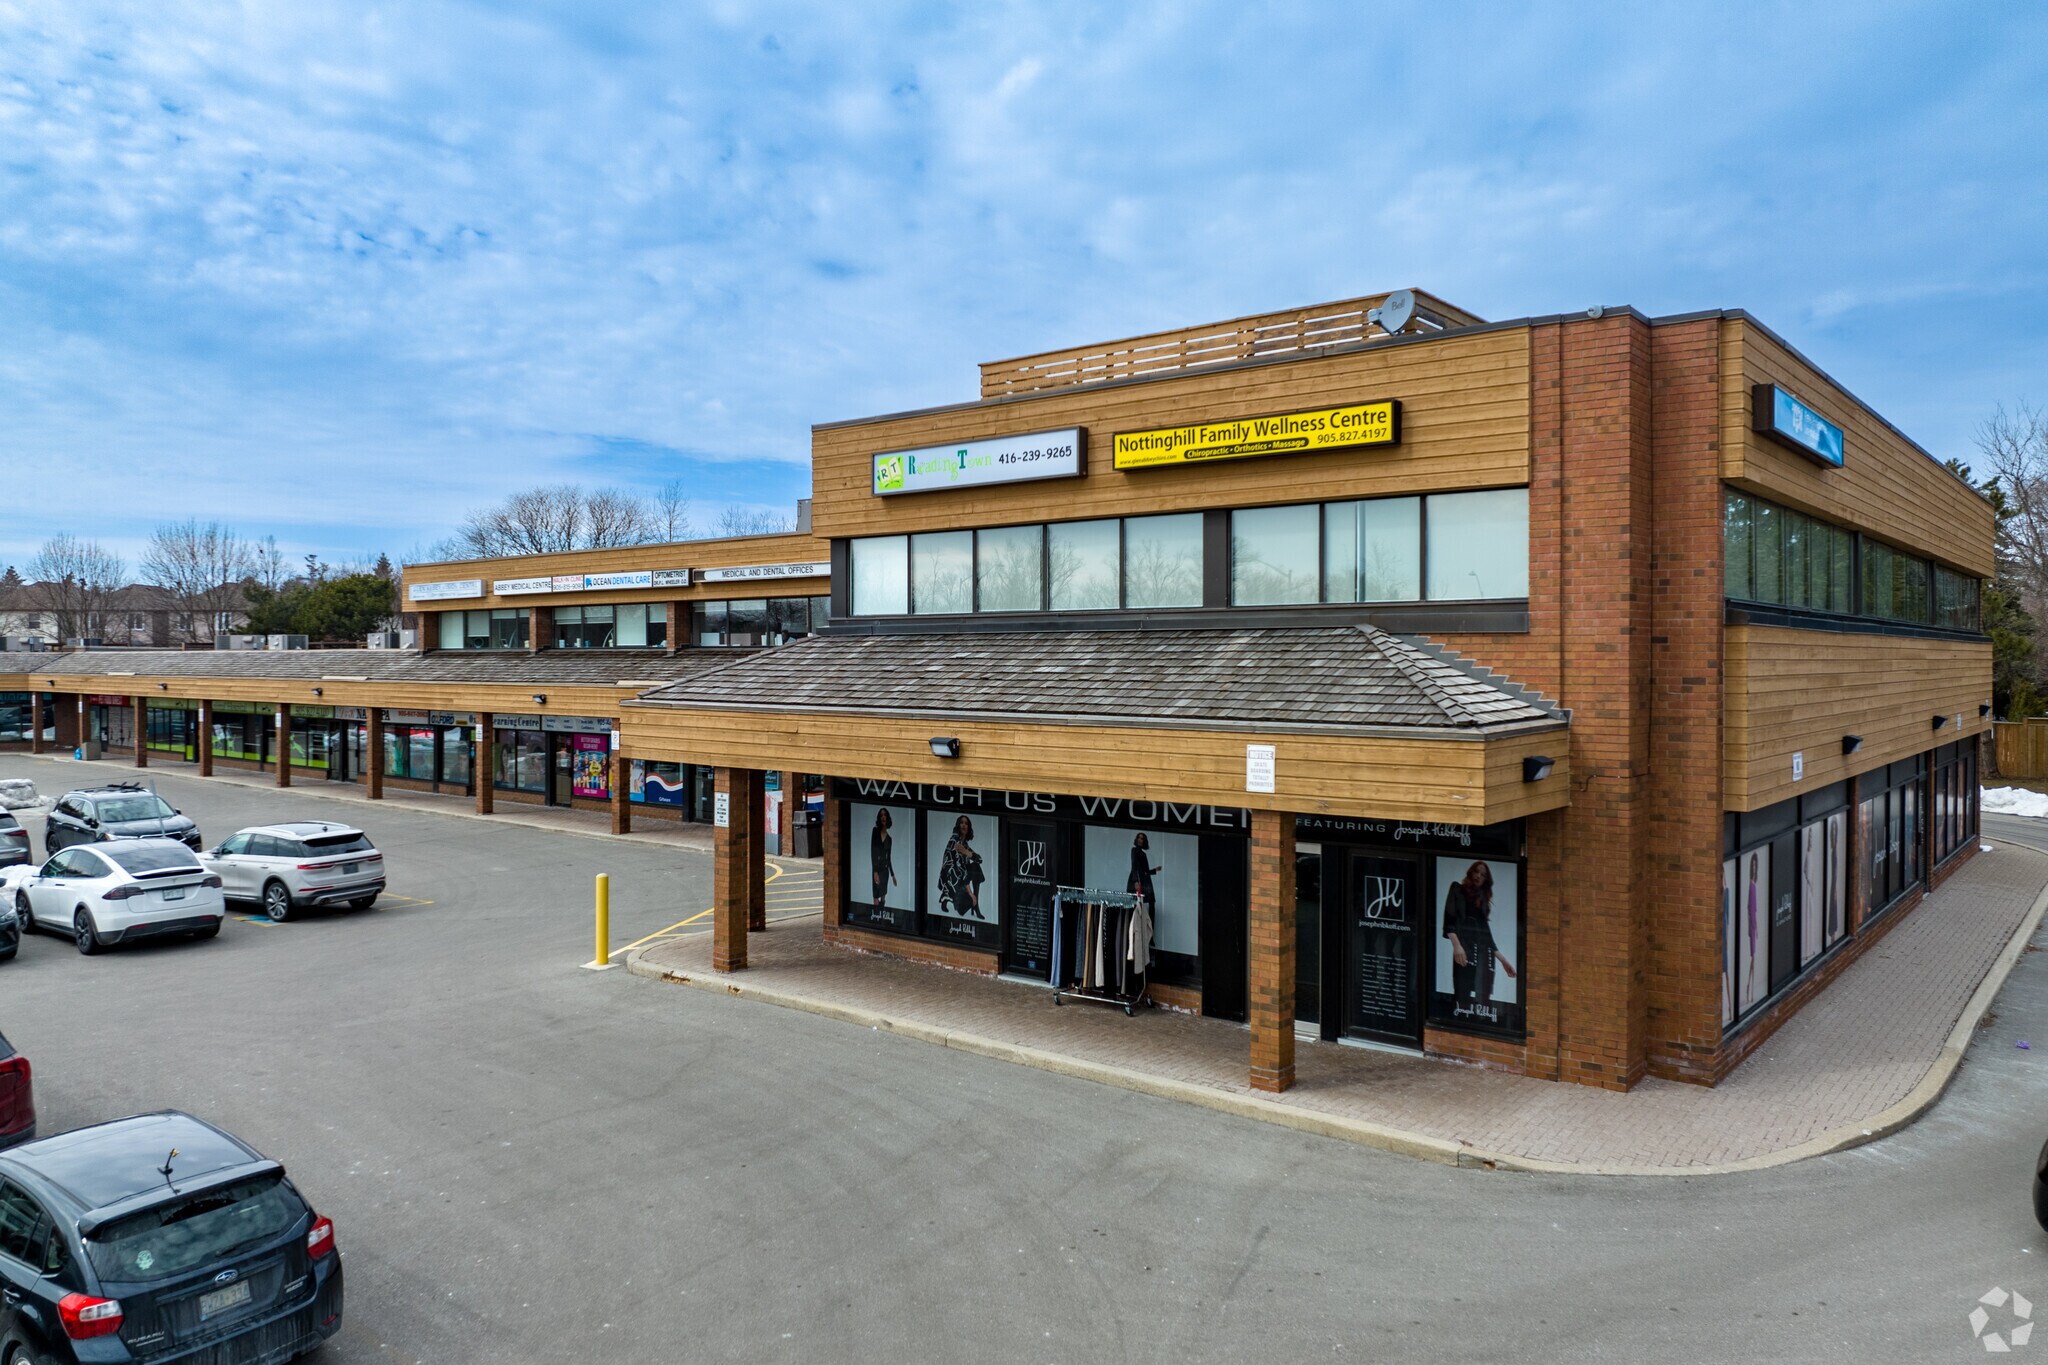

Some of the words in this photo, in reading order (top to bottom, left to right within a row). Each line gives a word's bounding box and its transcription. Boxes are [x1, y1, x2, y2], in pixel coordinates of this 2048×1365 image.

[1119, 428, 1195, 453] Nottinghill
[1200, 423, 1250, 443] Family
[1254, 417, 1325, 437] Wellness
[1330, 410, 1387, 429] Centre
[1317, 428, 1387, 444] 905.827.4197
[998, 445, 1072, 465] 416-239-9265
[1187, 447, 1229, 459] Chiropractic
[1233, 443, 1267, 453] Orthotics
[1272, 439, 1306, 449] Massage
[655, 570, 686, 579] OPTOMETRIST
[721, 570, 746, 578] MEDICAL
[748, 568, 761, 577] AND
[763, 567, 785, 576] DENTAL
[788, 565, 814, 575] OFFICES
[511, 582, 532, 590] MEDICAL
[532, 581, 552, 589] CENTRE
[593, 577, 611, 586] OCEAN
[612, 576, 635, 585] DENTAL
[636, 575, 650, 584] CARE
[493, 716, 517, 727] earning
[518, 716, 539, 728] Centre
[855, 777, 982, 807] WATCH
[1005, 790, 1056, 813] US
[1296, 818, 1386, 833] FEATURING
[1394, 820, 1431, 842] Joseph
